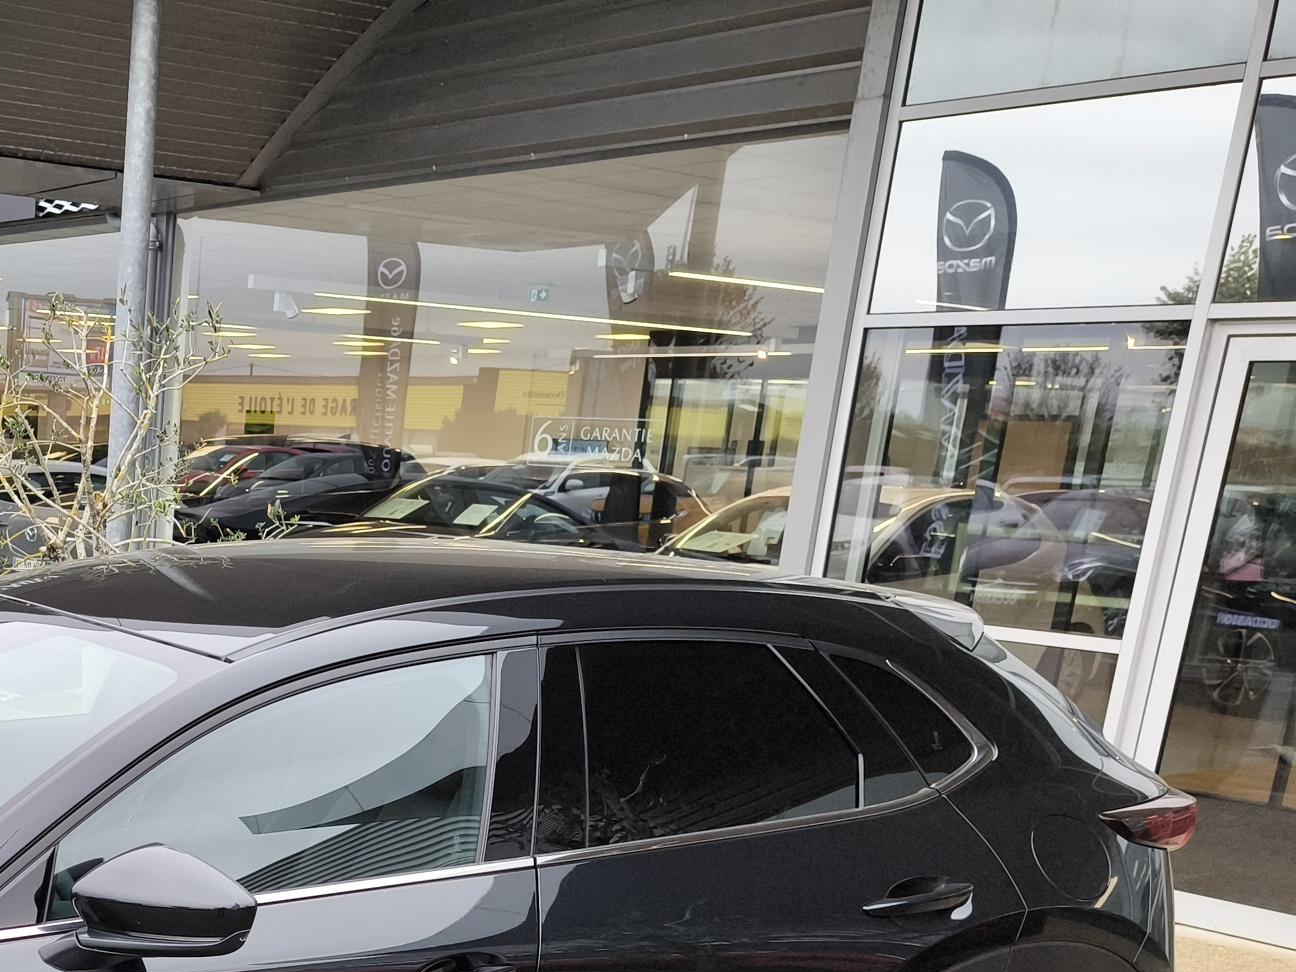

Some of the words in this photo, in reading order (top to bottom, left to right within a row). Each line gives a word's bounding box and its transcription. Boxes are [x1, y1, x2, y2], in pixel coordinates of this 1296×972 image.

[534, 420, 553, 458] 6
[557, 424, 568, 454] ANS
[580, 426, 653, 444] GARANTIE
[586, 445, 642, 462] MAZDA
